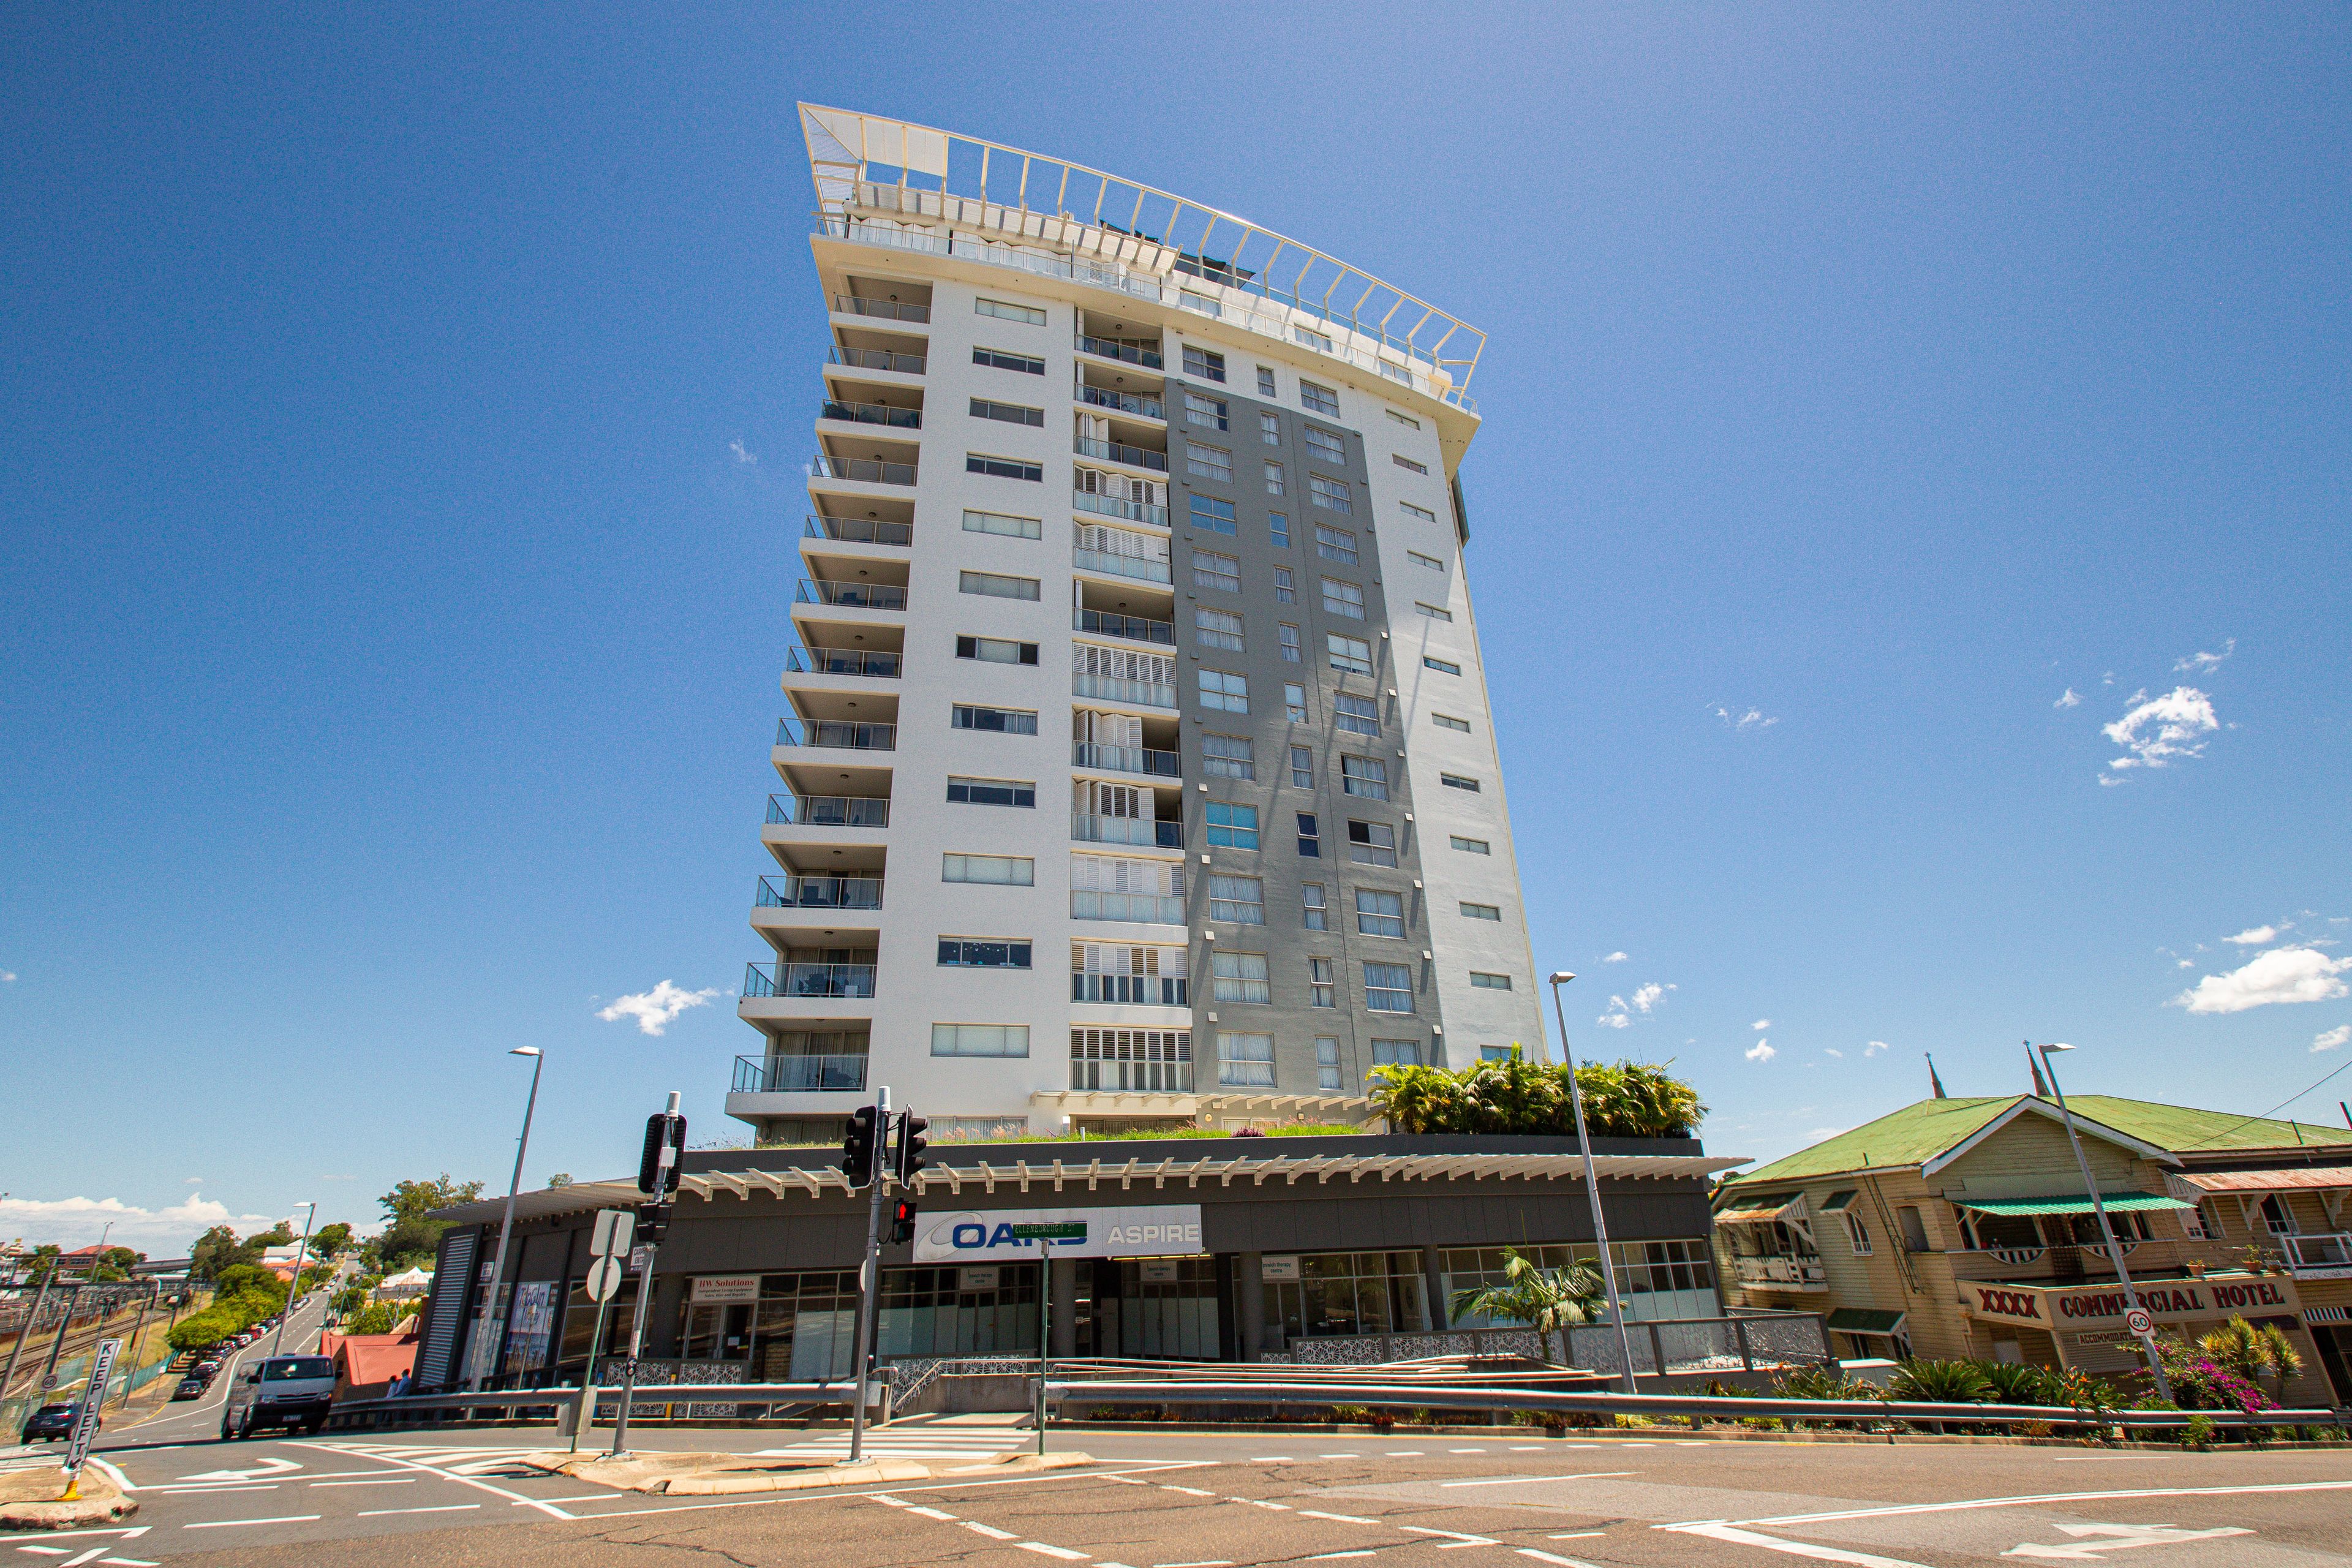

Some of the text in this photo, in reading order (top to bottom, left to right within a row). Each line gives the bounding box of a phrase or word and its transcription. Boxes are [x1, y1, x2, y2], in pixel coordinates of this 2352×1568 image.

[1015, 1223, 1063, 1234] ELLENBOROUGH
[1106, 1224, 1199, 1245] ASPIRE
[715, 1278, 755, 1287] Solutions
[1976, 1288, 2042, 1319] XXXX
[2059, 1283, 2285, 1317] COMMERCIAL HOTEL
[2132, 1317, 2147, 1327] 60
[75, 1343, 113, 1455] KEEP LEFT
